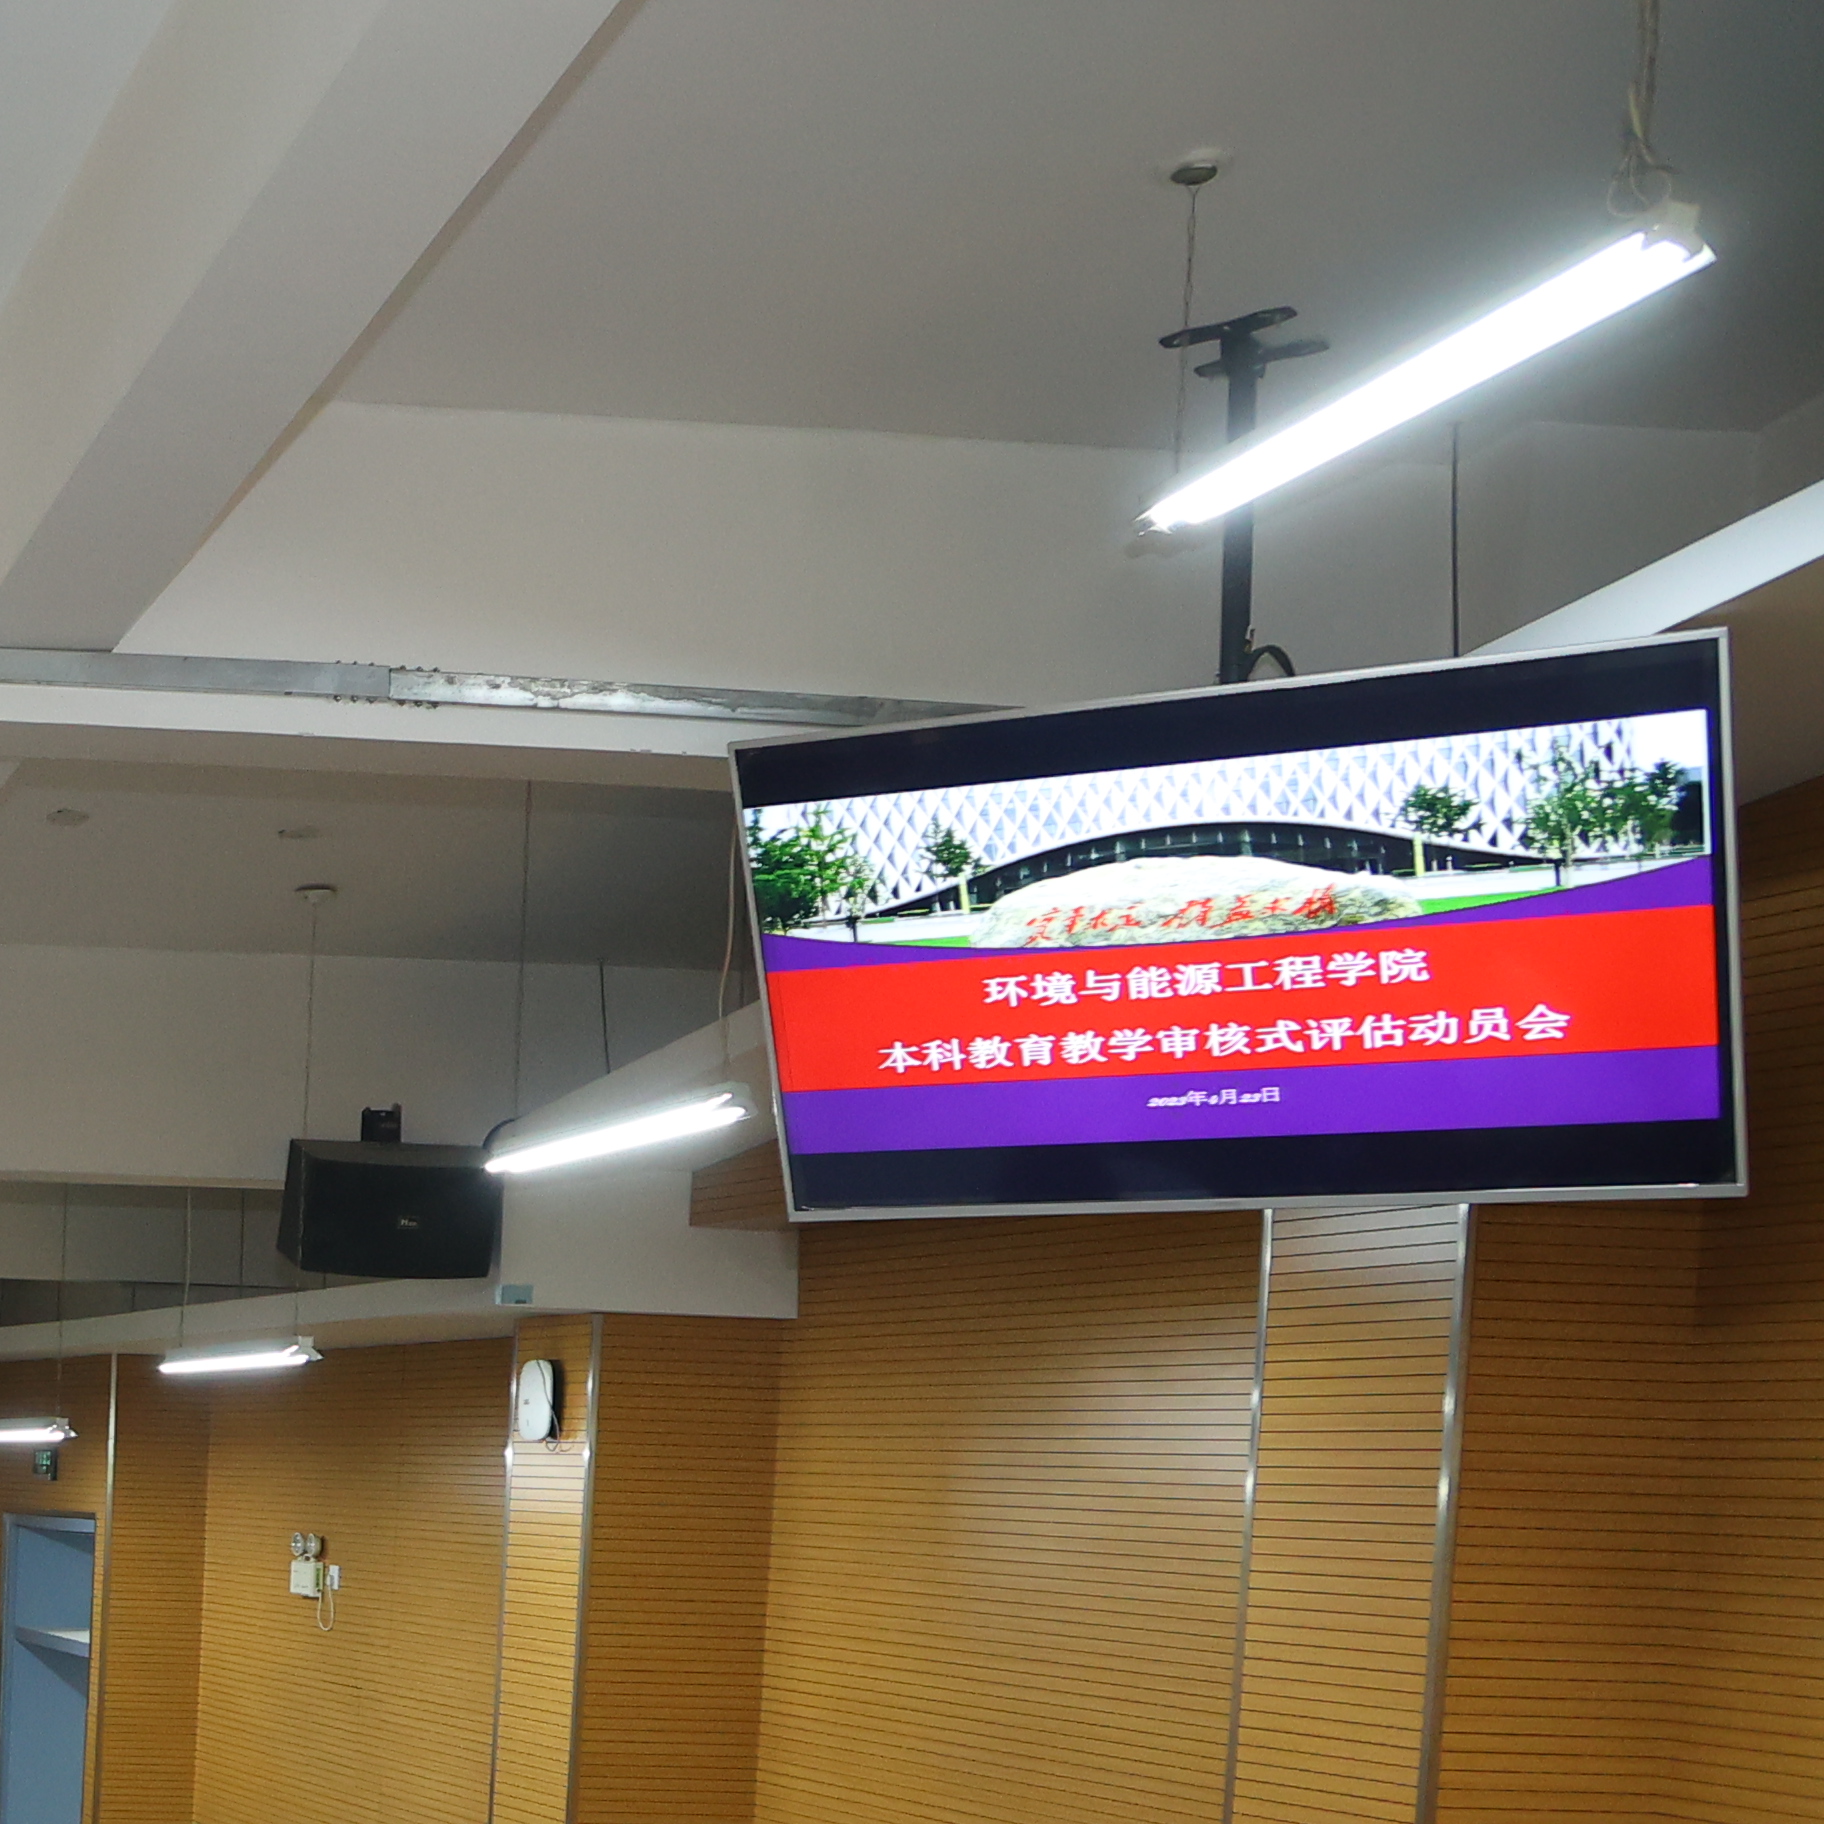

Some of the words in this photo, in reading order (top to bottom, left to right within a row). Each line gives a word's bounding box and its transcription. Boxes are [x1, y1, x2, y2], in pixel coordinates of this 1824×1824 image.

[981, 946, 1432, 1008] 环境与能源工程学院
[877, 1002, 1572, 1075] 本科教育教学审核式评估动员会
